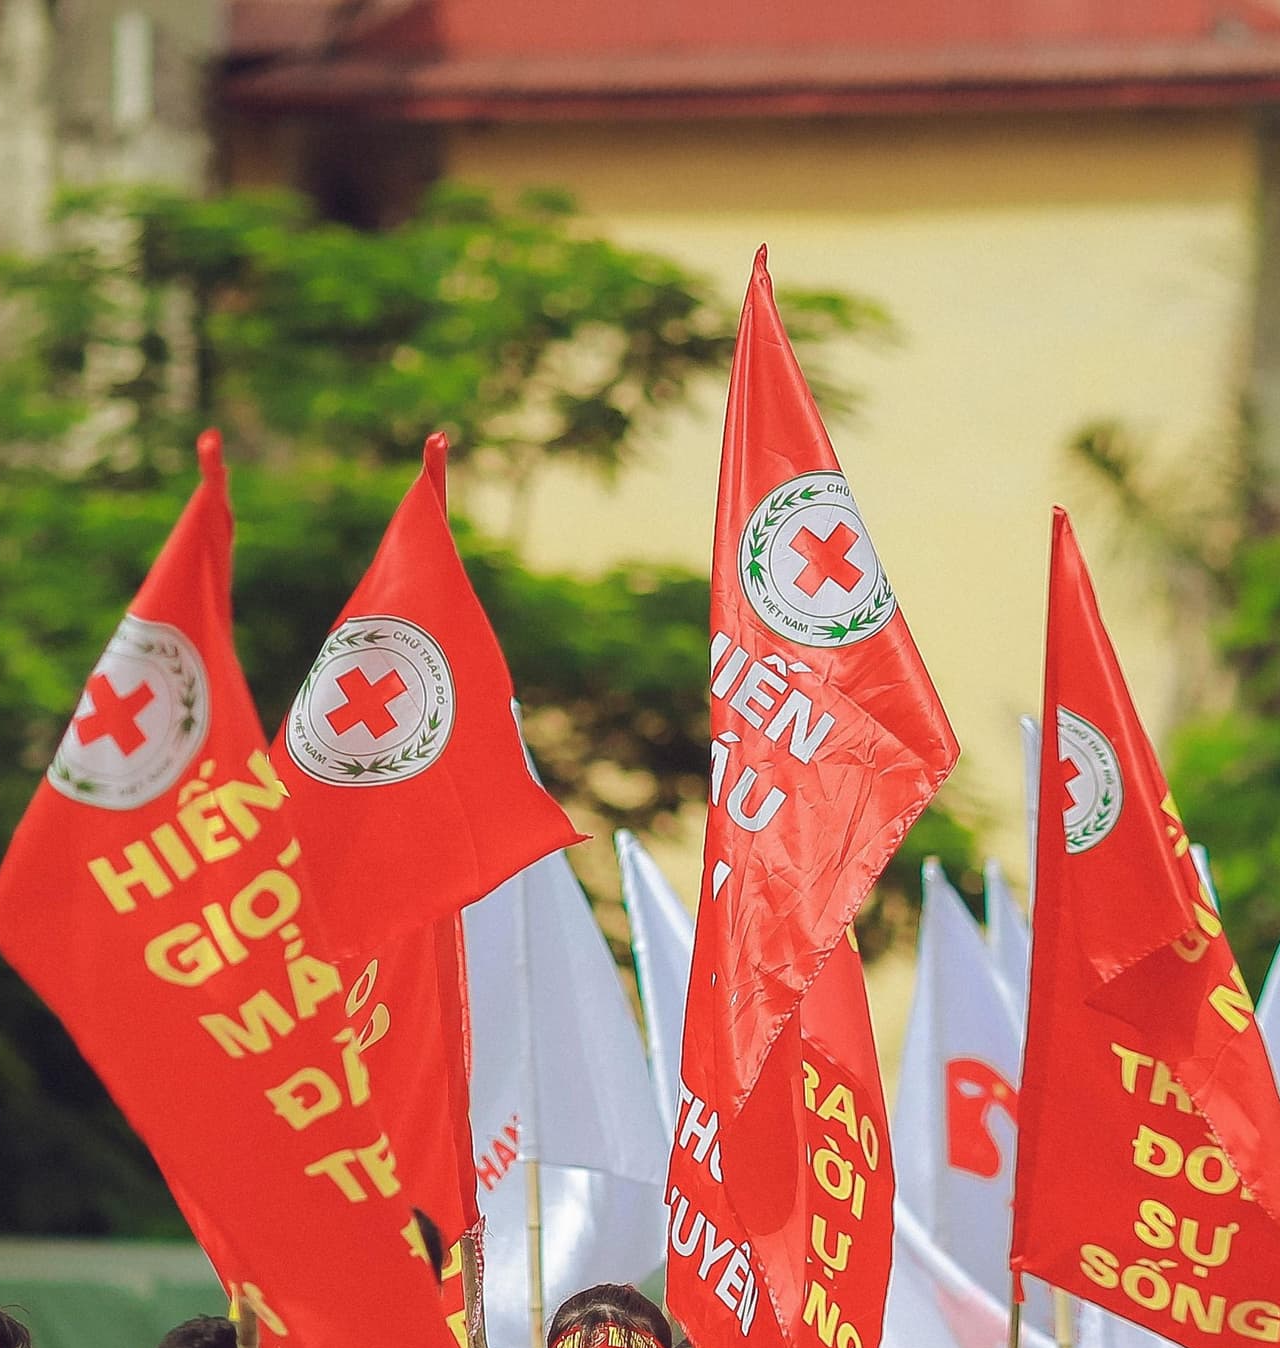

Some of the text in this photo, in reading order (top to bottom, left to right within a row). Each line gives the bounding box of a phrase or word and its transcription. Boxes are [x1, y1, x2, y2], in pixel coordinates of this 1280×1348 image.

[762, 595, 809, 634] VIỆT NAM
[418, 648, 442, 683] THẬP
[302, 741, 328, 766] NAM
[87, 749, 291, 915] HIẾN
[143, 836, 302, 988] GIỌ
[197, 938, 343, 1060] MÁ
[801, 1059, 880, 1172] RAO
[807, 1133, 867, 1221] ỜI
[669, 1185, 759, 1338] UYÊN
[809, 1213, 854, 1280] Ự
[1134, 1198, 1240, 1278] SỰ
